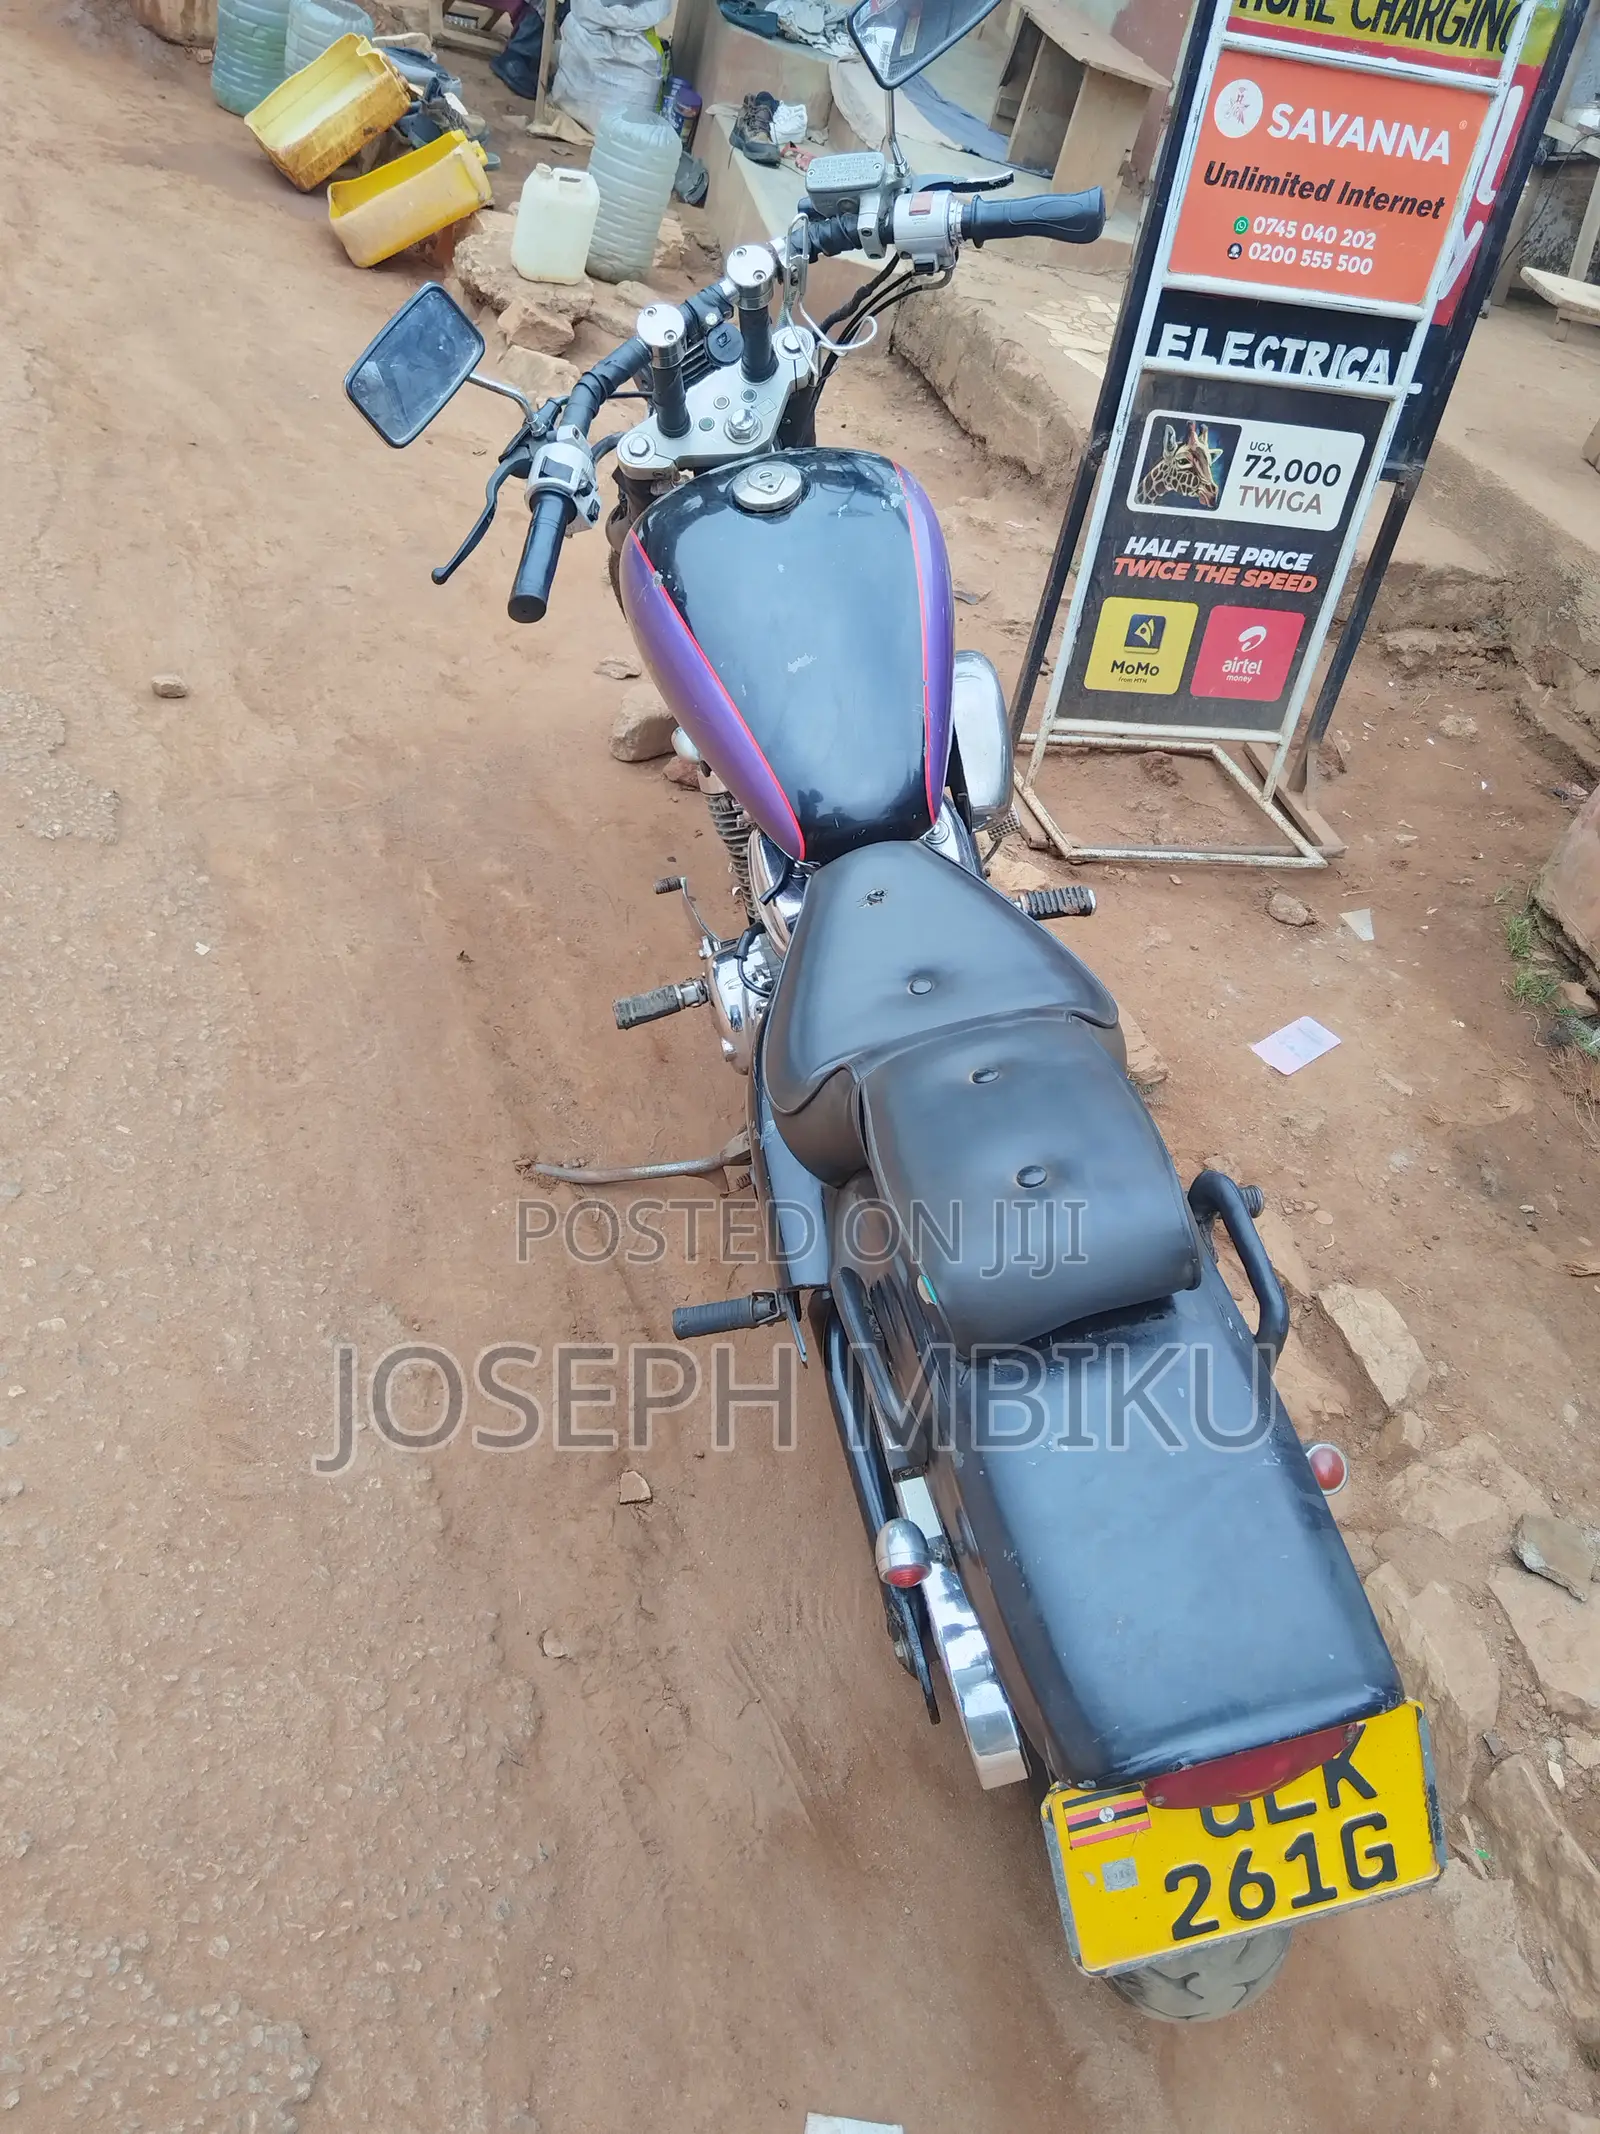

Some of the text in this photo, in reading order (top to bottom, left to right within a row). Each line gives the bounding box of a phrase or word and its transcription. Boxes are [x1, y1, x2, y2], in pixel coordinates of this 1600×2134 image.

[1267, 103, 1450, 165] SAVANNA
[1204, 160, 1445, 219] Unlimited Internet
[1253, 216, 1376, 250] 0745 040 202
[1248, 242, 1373, 275] 0200 555 500
[1249, 440, 1274, 453] UGX
[1242, 454, 1342, 486] 72,000
[1238, 484, 1322, 515] TWIGA
[1123, 535, 1314, 572] HALF THE PRICE
[1112, 557, 1318, 593] TWICE THE SPEED
[1110, 660, 1160, 676] MoMo
[1222, 656, 1263, 675] airtel
[1226, 674, 1253, 684] money
[1164, 1812, 1398, 1941] 261G
